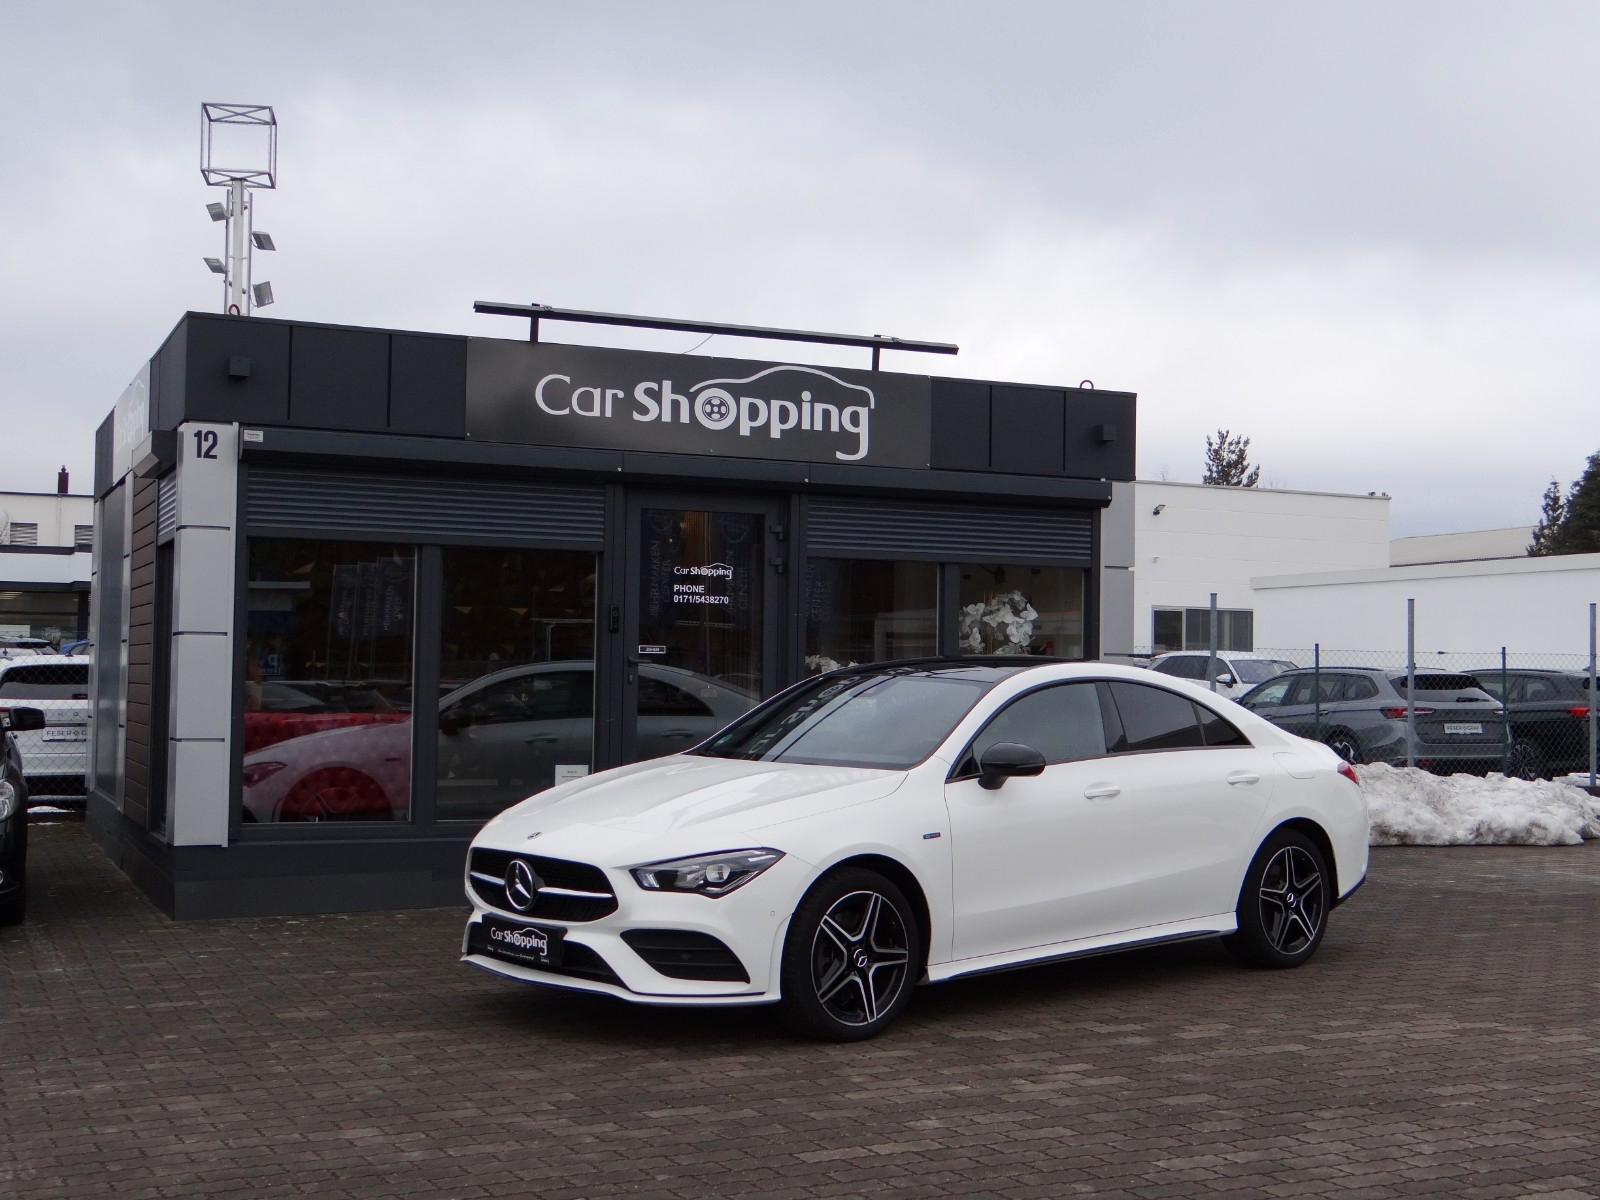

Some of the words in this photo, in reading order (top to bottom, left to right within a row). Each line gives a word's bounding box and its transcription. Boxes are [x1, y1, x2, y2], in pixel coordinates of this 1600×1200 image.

[535, 374, 624, 417] Car
[633, 378, 869, 460] Shopping
[194, 430, 217, 459] 12
[690, 566, 733, 579] Shopping
[673, 584, 705, 593] PHONE
[673, 595, 729, 604] 0171/5438270
[491, 927, 503, 940] Car
[504, 930, 547, 955] Shopping
